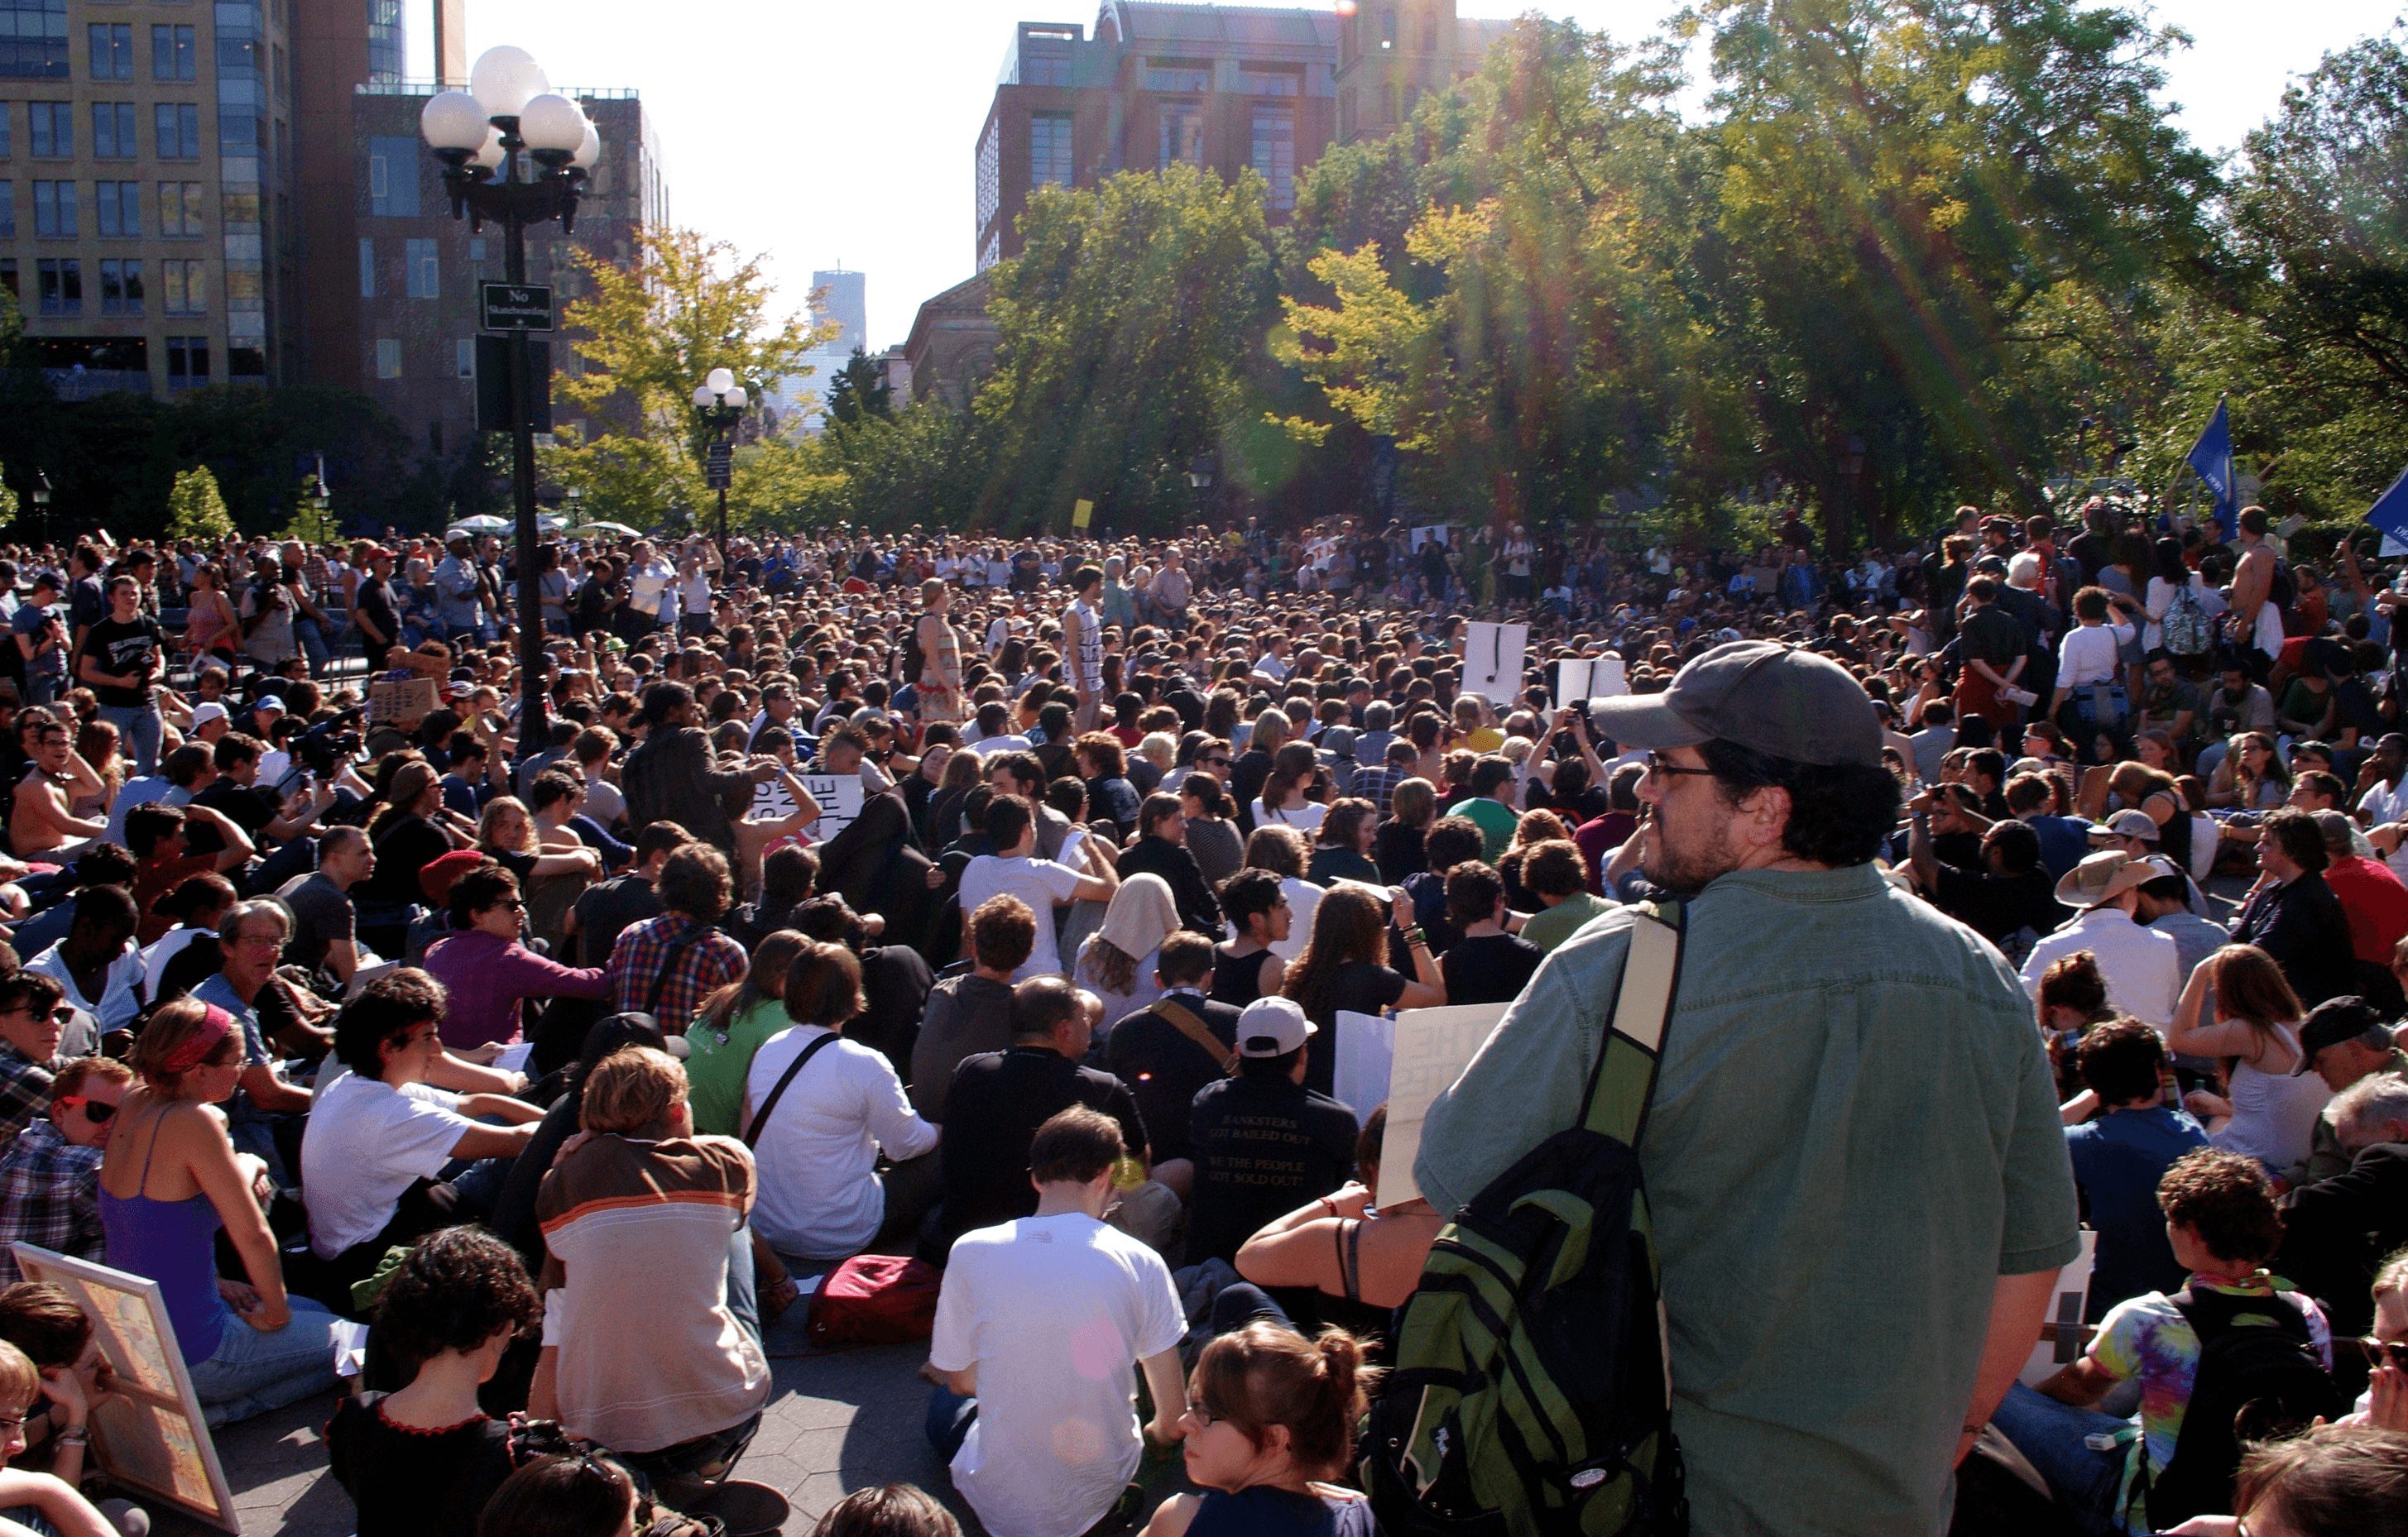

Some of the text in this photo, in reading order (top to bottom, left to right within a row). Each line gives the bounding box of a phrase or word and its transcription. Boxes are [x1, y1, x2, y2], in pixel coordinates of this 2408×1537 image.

[509, 290, 529, 302] No
[488, 304, 550, 318] Skateboarding
[809, 779, 842, 829] THE
[1222, 1115, 1298, 1129] BANKSTERS
[1231, 1128, 1281, 1142] BAILED
[1282, 1132, 1312, 1146] OUT
[1228, 1156, 1252, 1169] THE
[1254, 1158, 1305, 1172] PEOPLE
[1234, 1172, 1269, 1185] SOLD
